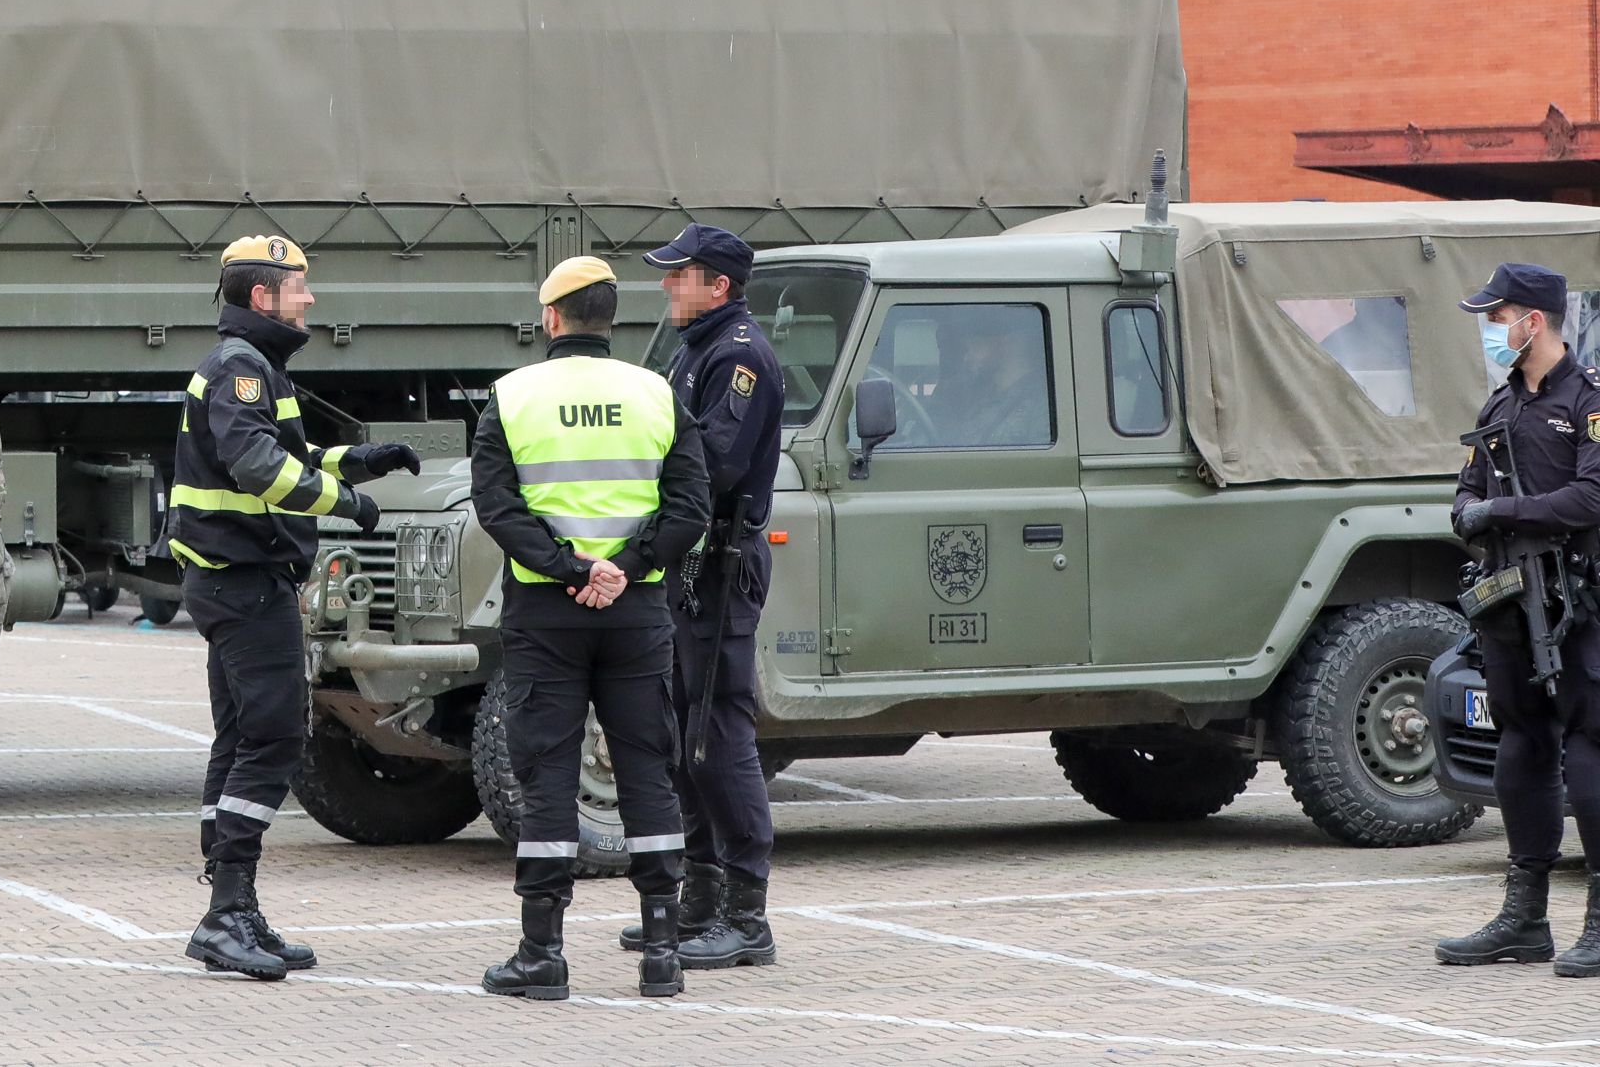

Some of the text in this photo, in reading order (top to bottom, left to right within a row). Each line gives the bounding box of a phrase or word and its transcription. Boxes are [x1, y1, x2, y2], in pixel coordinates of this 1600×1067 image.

[559, 403, 623, 428] UME
[939, 619, 977, 637] RI 31
